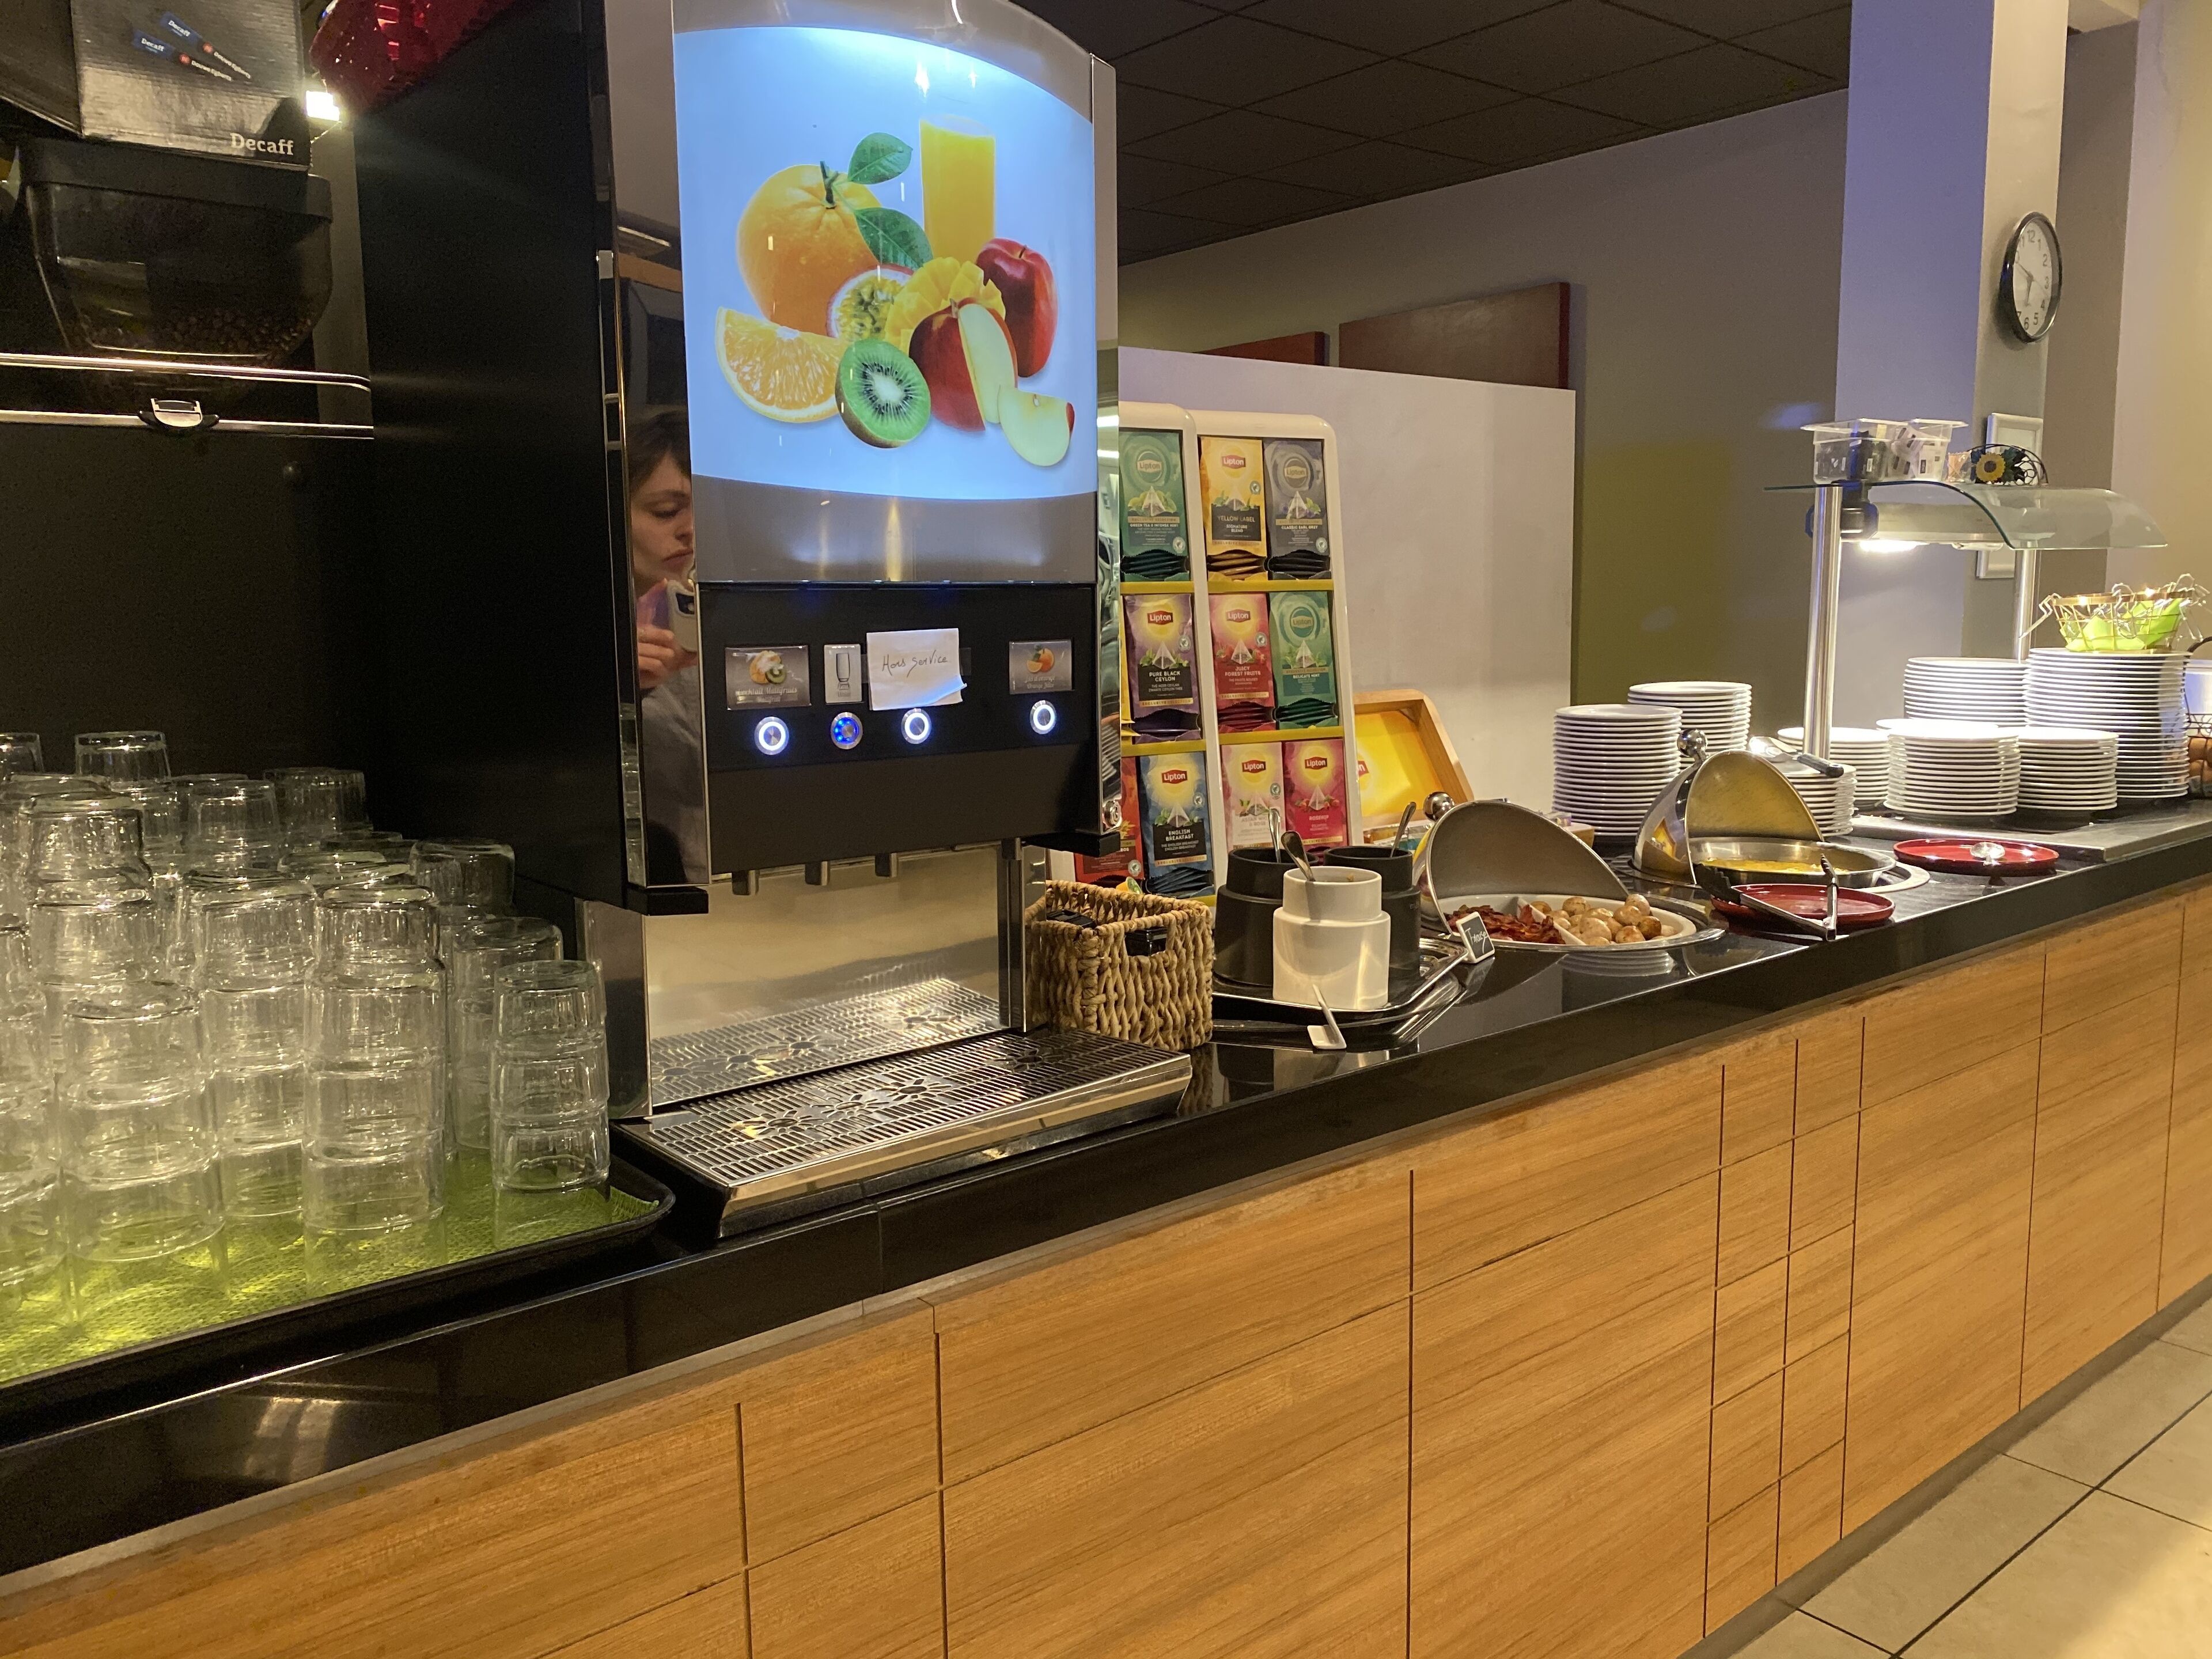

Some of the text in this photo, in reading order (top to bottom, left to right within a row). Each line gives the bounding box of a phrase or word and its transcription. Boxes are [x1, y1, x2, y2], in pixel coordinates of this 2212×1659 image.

[168, 20, 191, 37] Decaff
[141, 38, 165, 51] Decaff
[229, 132, 294, 156] Decaff
[2027, 230, 2035, 243] 12
[2037, 238, 2041, 251] 1
[2043, 253, 2047, 266] 2
[2045, 276, 2050, 289] 3
[2041, 299, 2045, 311] 4
[2024, 317, 2029, 330] 6
[2033, 312, 2039, 325] 5
[1139, 462, 1160, 471] Lipton
[1224, 457, 1244, 465] Lipton
[1149, 614, 1171, 622] Lipton
[881, 654, 906, 676] Hors
[1306, 760, 1326, 768] Lipton
[1164, 773, 1185, 782] Lipton
[1165, 834, 1194, 842] BREAKFAST
